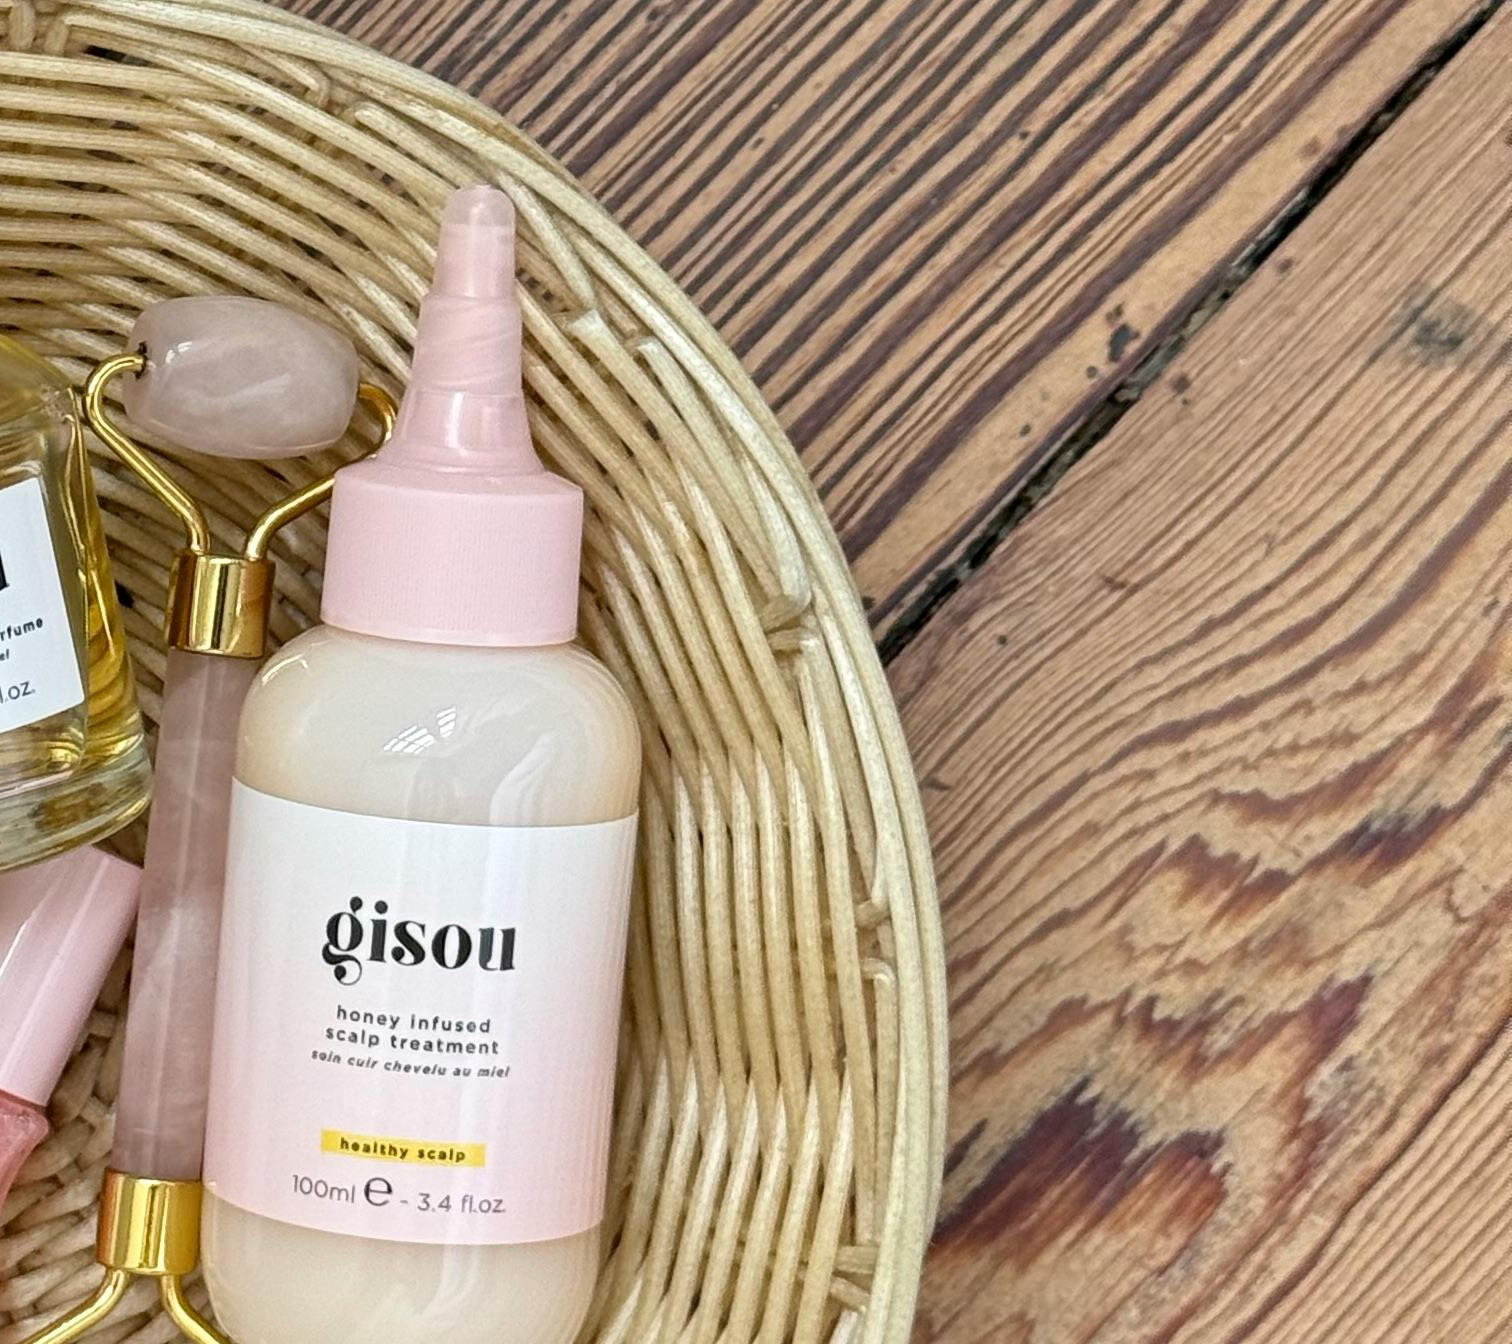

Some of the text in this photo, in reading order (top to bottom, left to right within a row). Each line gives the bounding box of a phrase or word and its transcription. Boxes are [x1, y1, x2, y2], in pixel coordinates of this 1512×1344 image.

[321, 896, 517, 986] gisou
[337, 1005, 491, 1034] honey infused
[325, 1026, 500, 1055] scalp treatment
[311, 1048, 511, 1079] soin cuir chevelu au miel
[339, 1136, 467, 1163] healthy scalp
[291, 1174, 356, 1203] 100ml
[417, 1192, 452, 1213] 3.4
